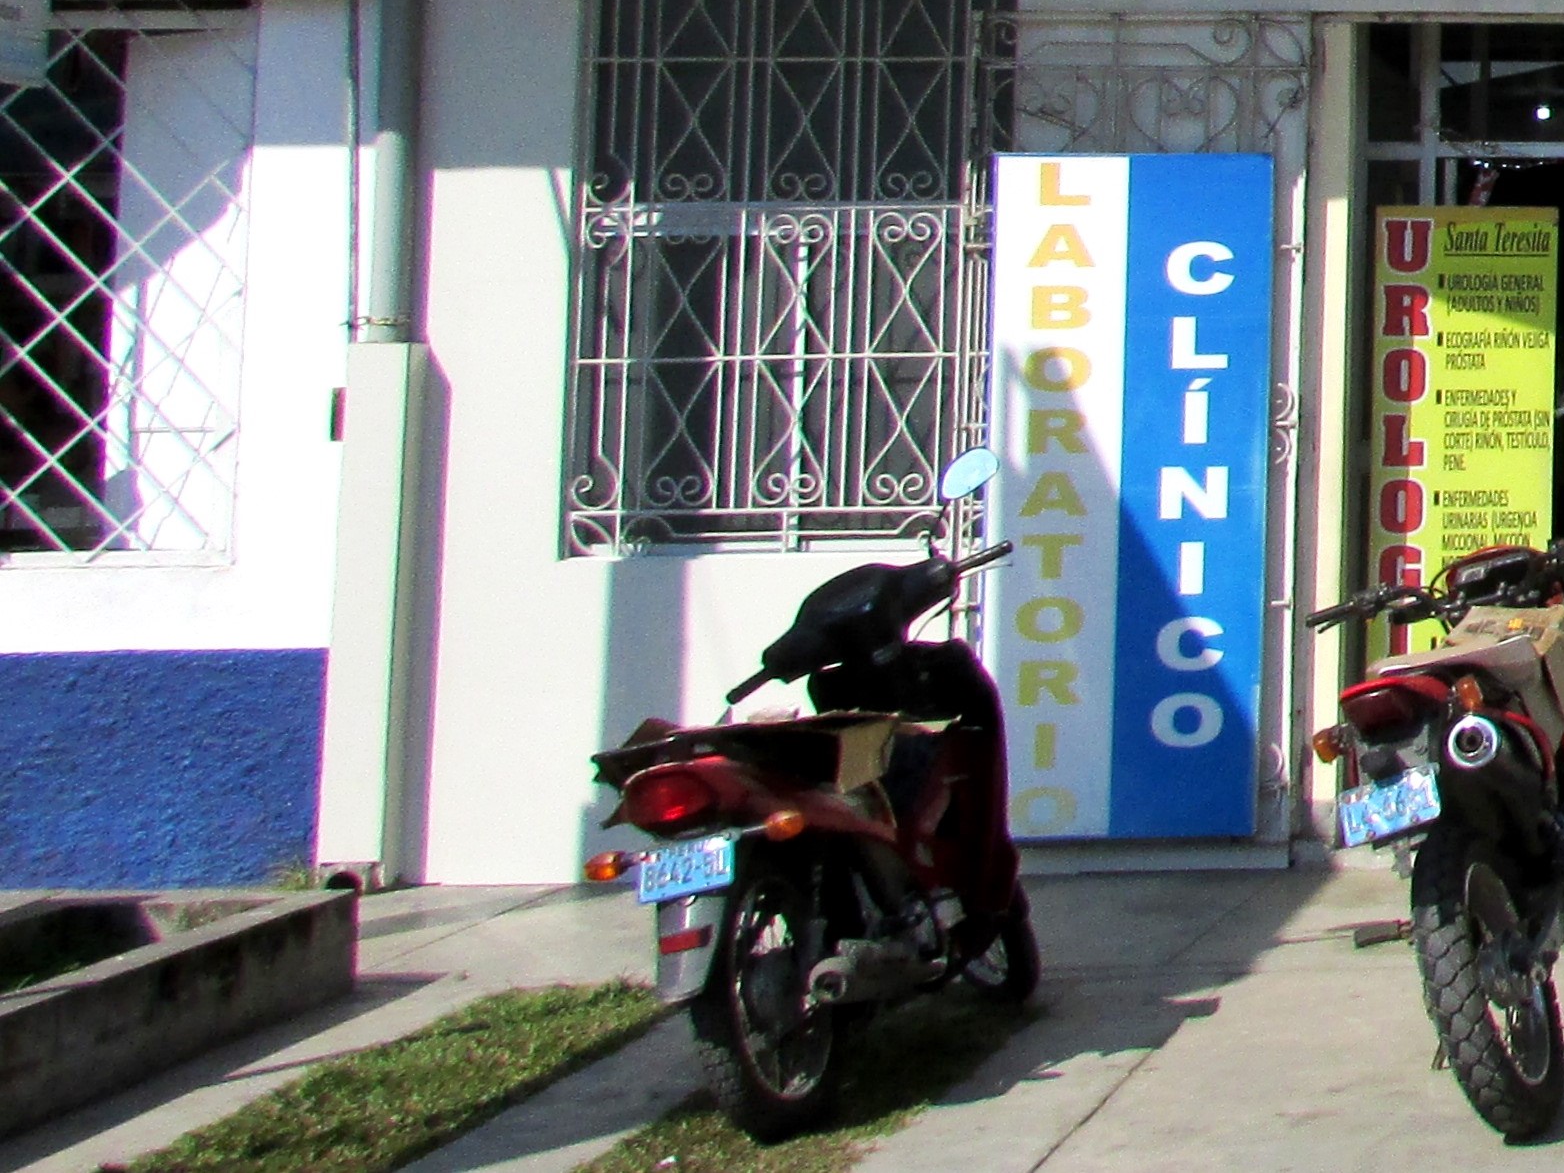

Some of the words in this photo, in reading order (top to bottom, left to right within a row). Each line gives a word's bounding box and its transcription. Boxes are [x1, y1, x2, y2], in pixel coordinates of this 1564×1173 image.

[1444, 222, 1488, 252] Santa
[1495, 222, 1551, 252] Teresita
[1447, 270, 1498, 292] UROLOGÍA
[1501, 273, 1544, 292] GENERAL
[1446, 294, 1494, 316] (ADULTOS
[1497, 295, 1502, 312] Y
[1505, 292, 1539, 316] NIÑOS)
[1446, 328, 1491, 348] ECOGRAFÍA
[1494, 328, 1520, 348] RIÑÓN
[1522, 332, 1550, 348] VEJIGA
[1445, 350, 1486, 370] PRÓSTATA
[1445, 389, 1509, 406] ENFERMEDADES
[1511, 389, 1518, 405] Y
[1445, 408, 1478, 428] CIRUGÍA
[1480, 410, 1490, 428] DE
[1533, 409, 1550, 430] (SIN
[1444, 431, 1473, 451] CORTE)
[1010, 162, 1097, 830] LABORATORIO
[1150, 239, 1235, 748] CLÍNICO
[1443, 490, 1509, 507] ENFERMEDADES
[1443, 511, 1488, 528] URINARIAS
